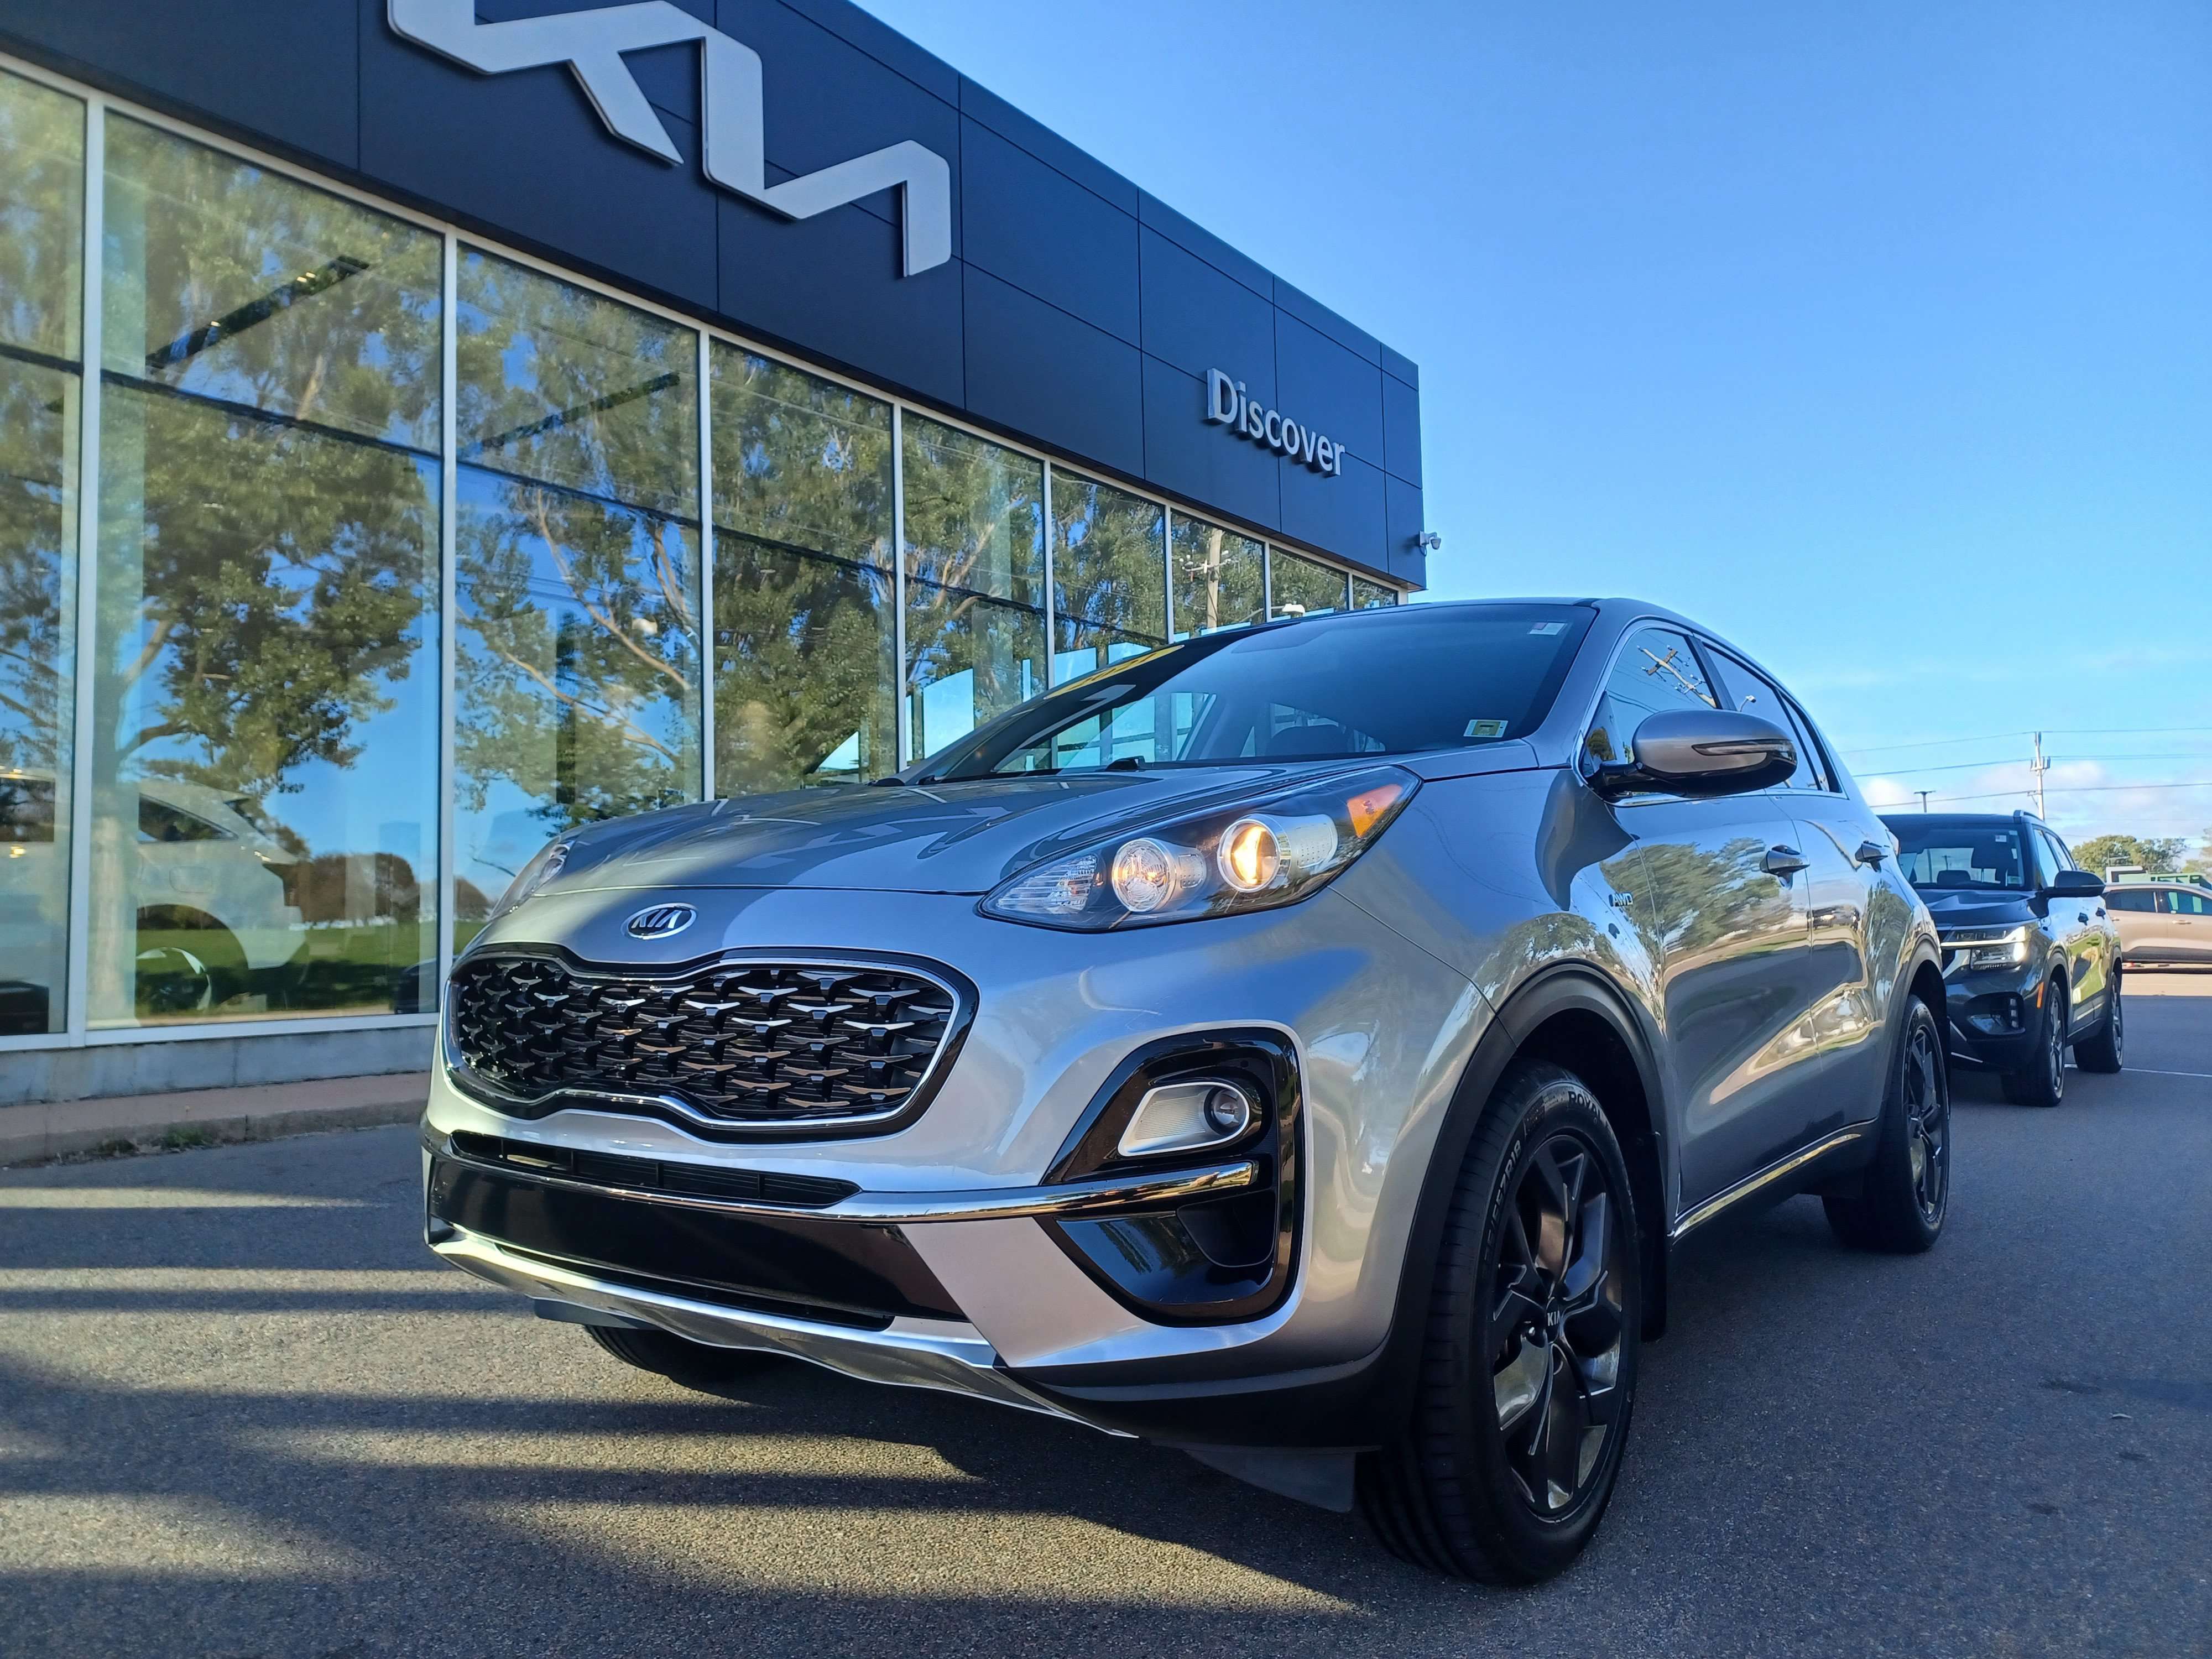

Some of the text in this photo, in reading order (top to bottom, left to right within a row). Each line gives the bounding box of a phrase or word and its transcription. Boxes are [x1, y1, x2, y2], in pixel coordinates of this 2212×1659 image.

[1207, 368, 1345, 476] Discover
[1611, 893, 1634, 907] AWD
[631, 909, 682, 929] KIA
[1547, 1310, 1561, 1327] KIA
